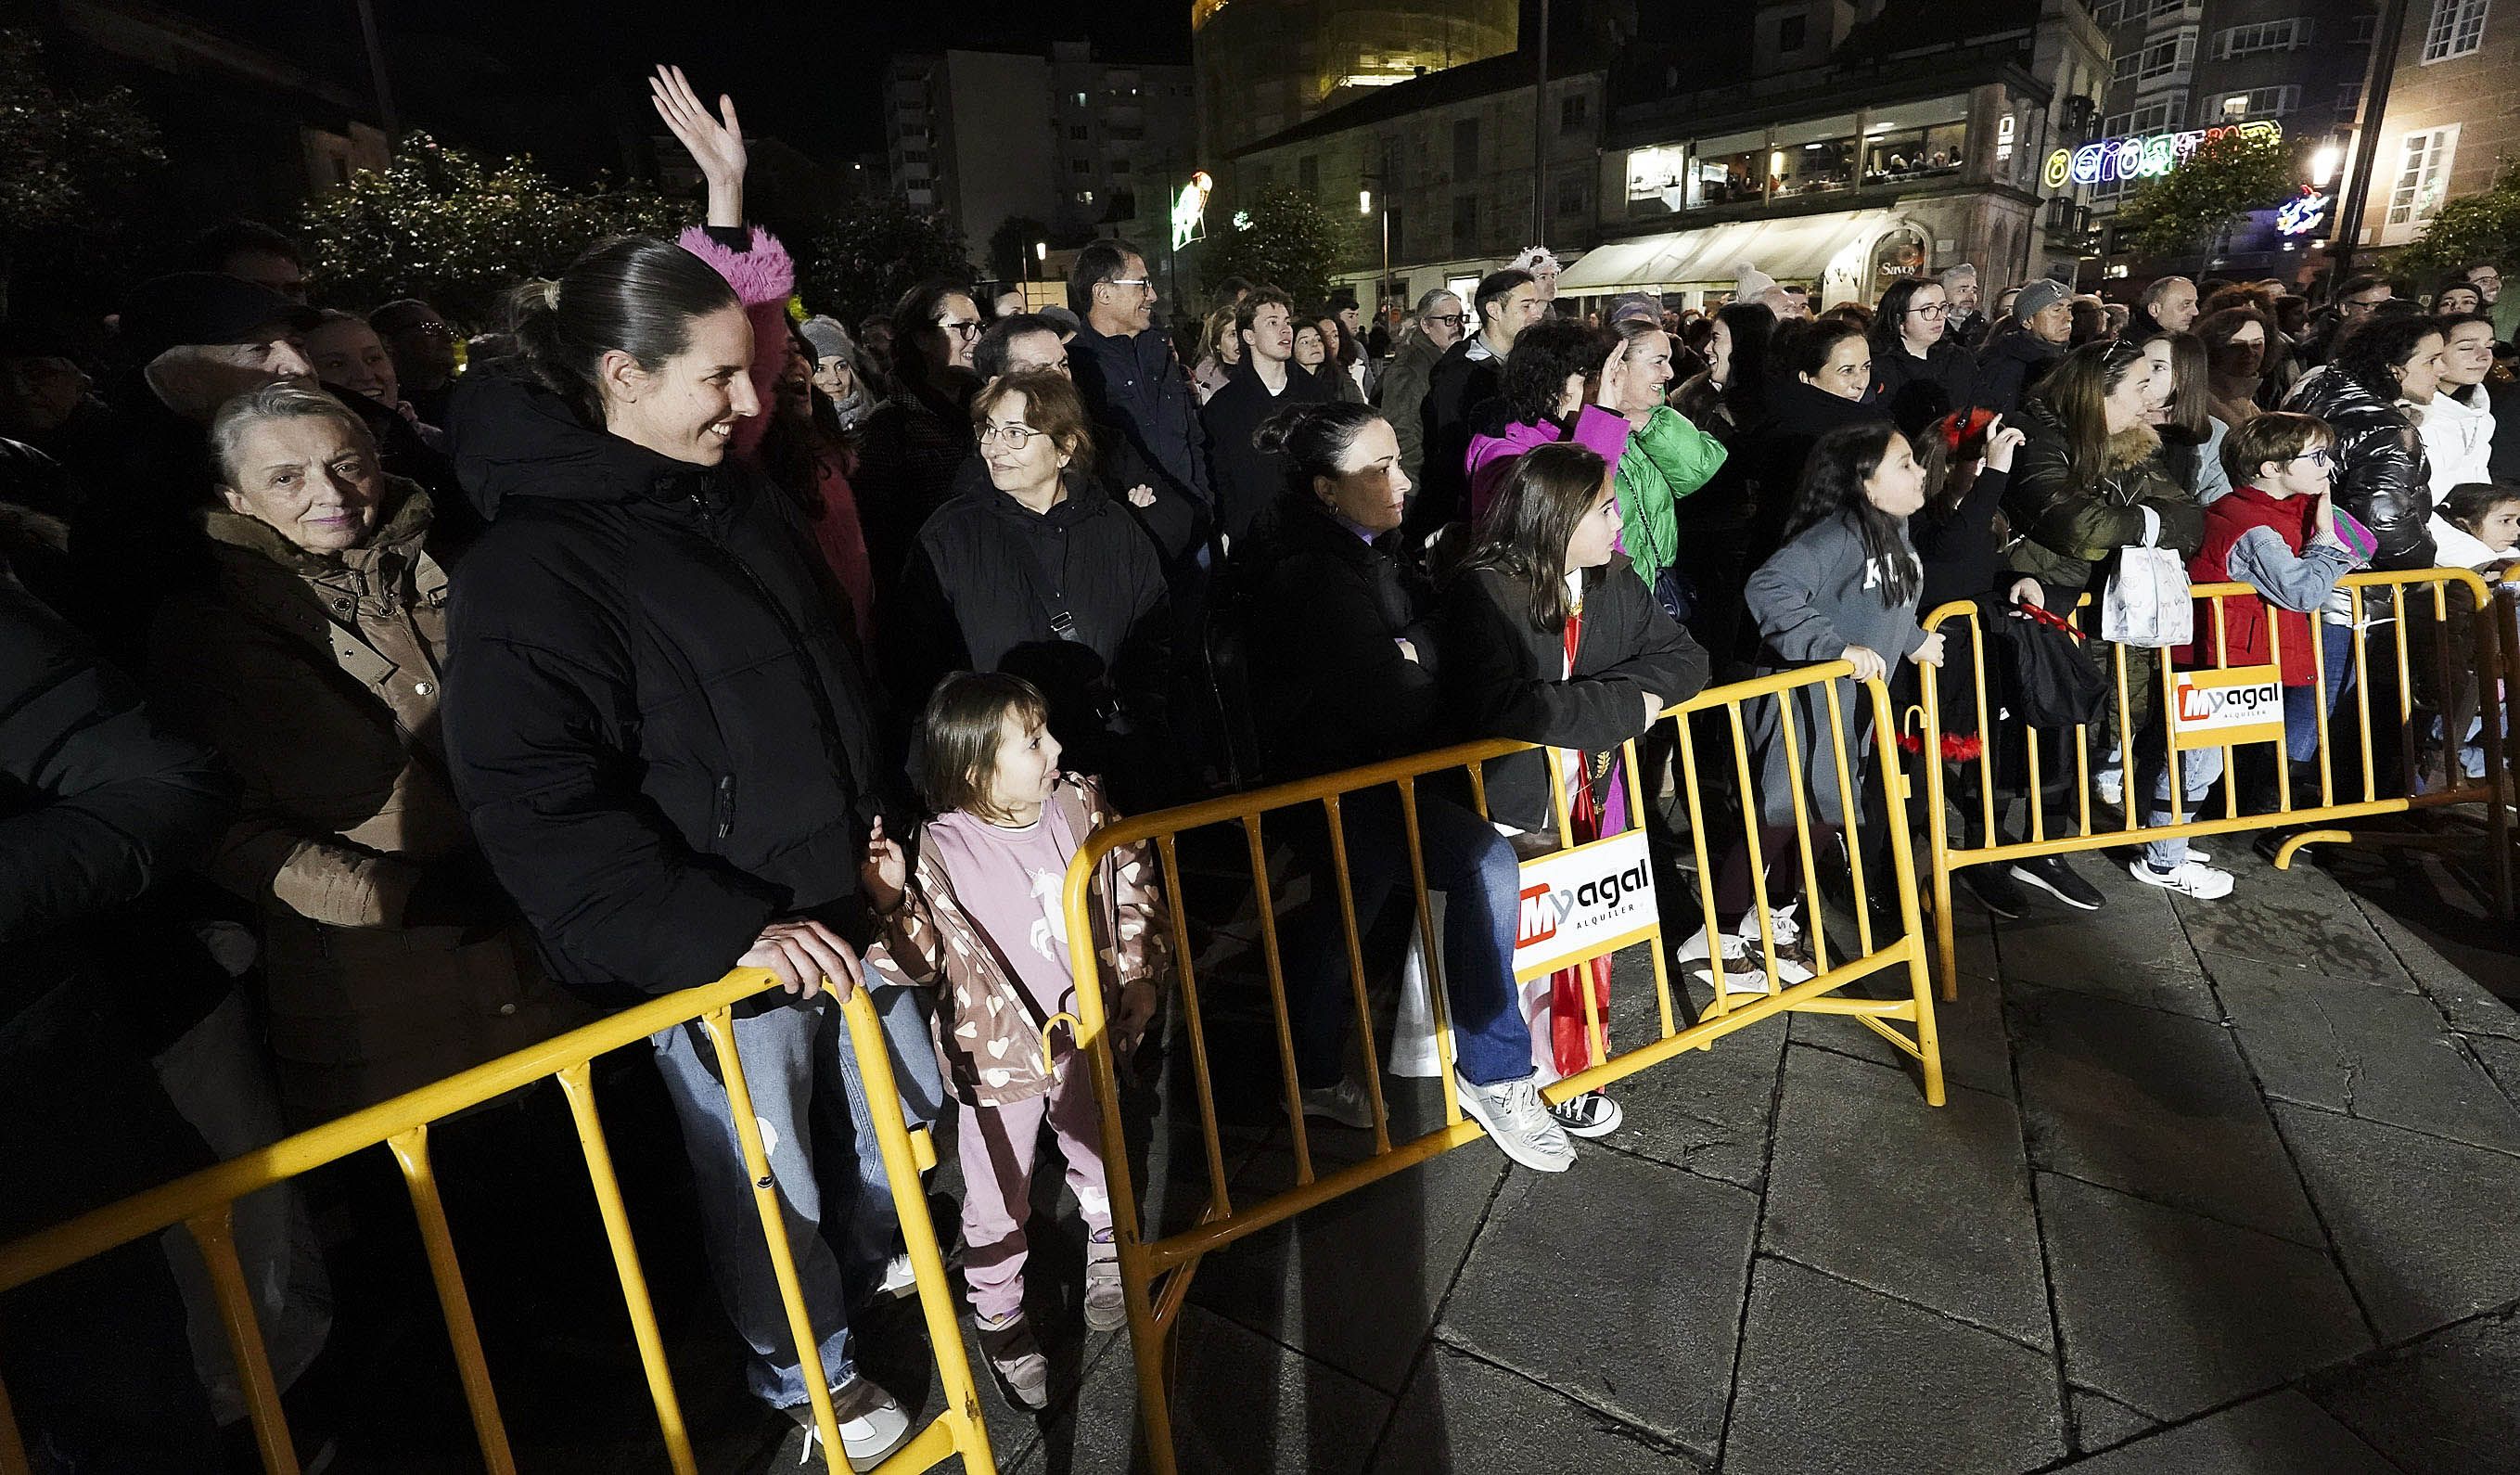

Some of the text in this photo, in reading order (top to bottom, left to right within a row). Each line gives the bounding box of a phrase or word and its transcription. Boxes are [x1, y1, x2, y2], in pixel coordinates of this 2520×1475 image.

[1881, 262, 1916, 276] Savoy
[2224, 711, 2266, 719] ALQUILER
[1577, 904, 1635, 930] ALQUILER
